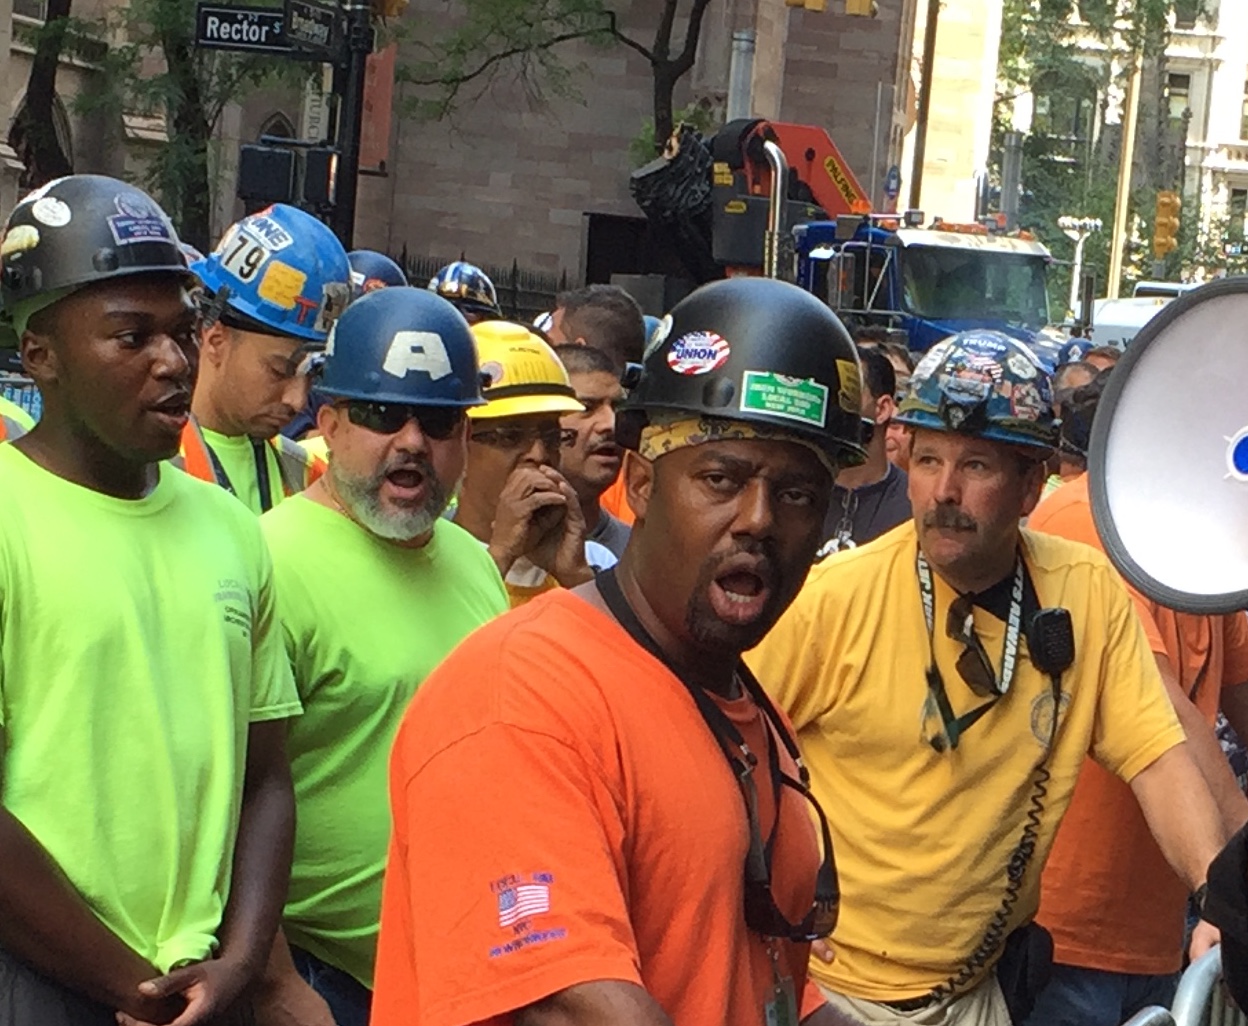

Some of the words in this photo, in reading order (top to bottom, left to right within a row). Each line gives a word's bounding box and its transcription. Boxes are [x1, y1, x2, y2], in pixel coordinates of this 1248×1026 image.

[206, 16, 269, 42] Rector
[224, 235, 265, 280] 79
[382, 330, 453, 381] A
[676, 348, 718, 361] UNION
